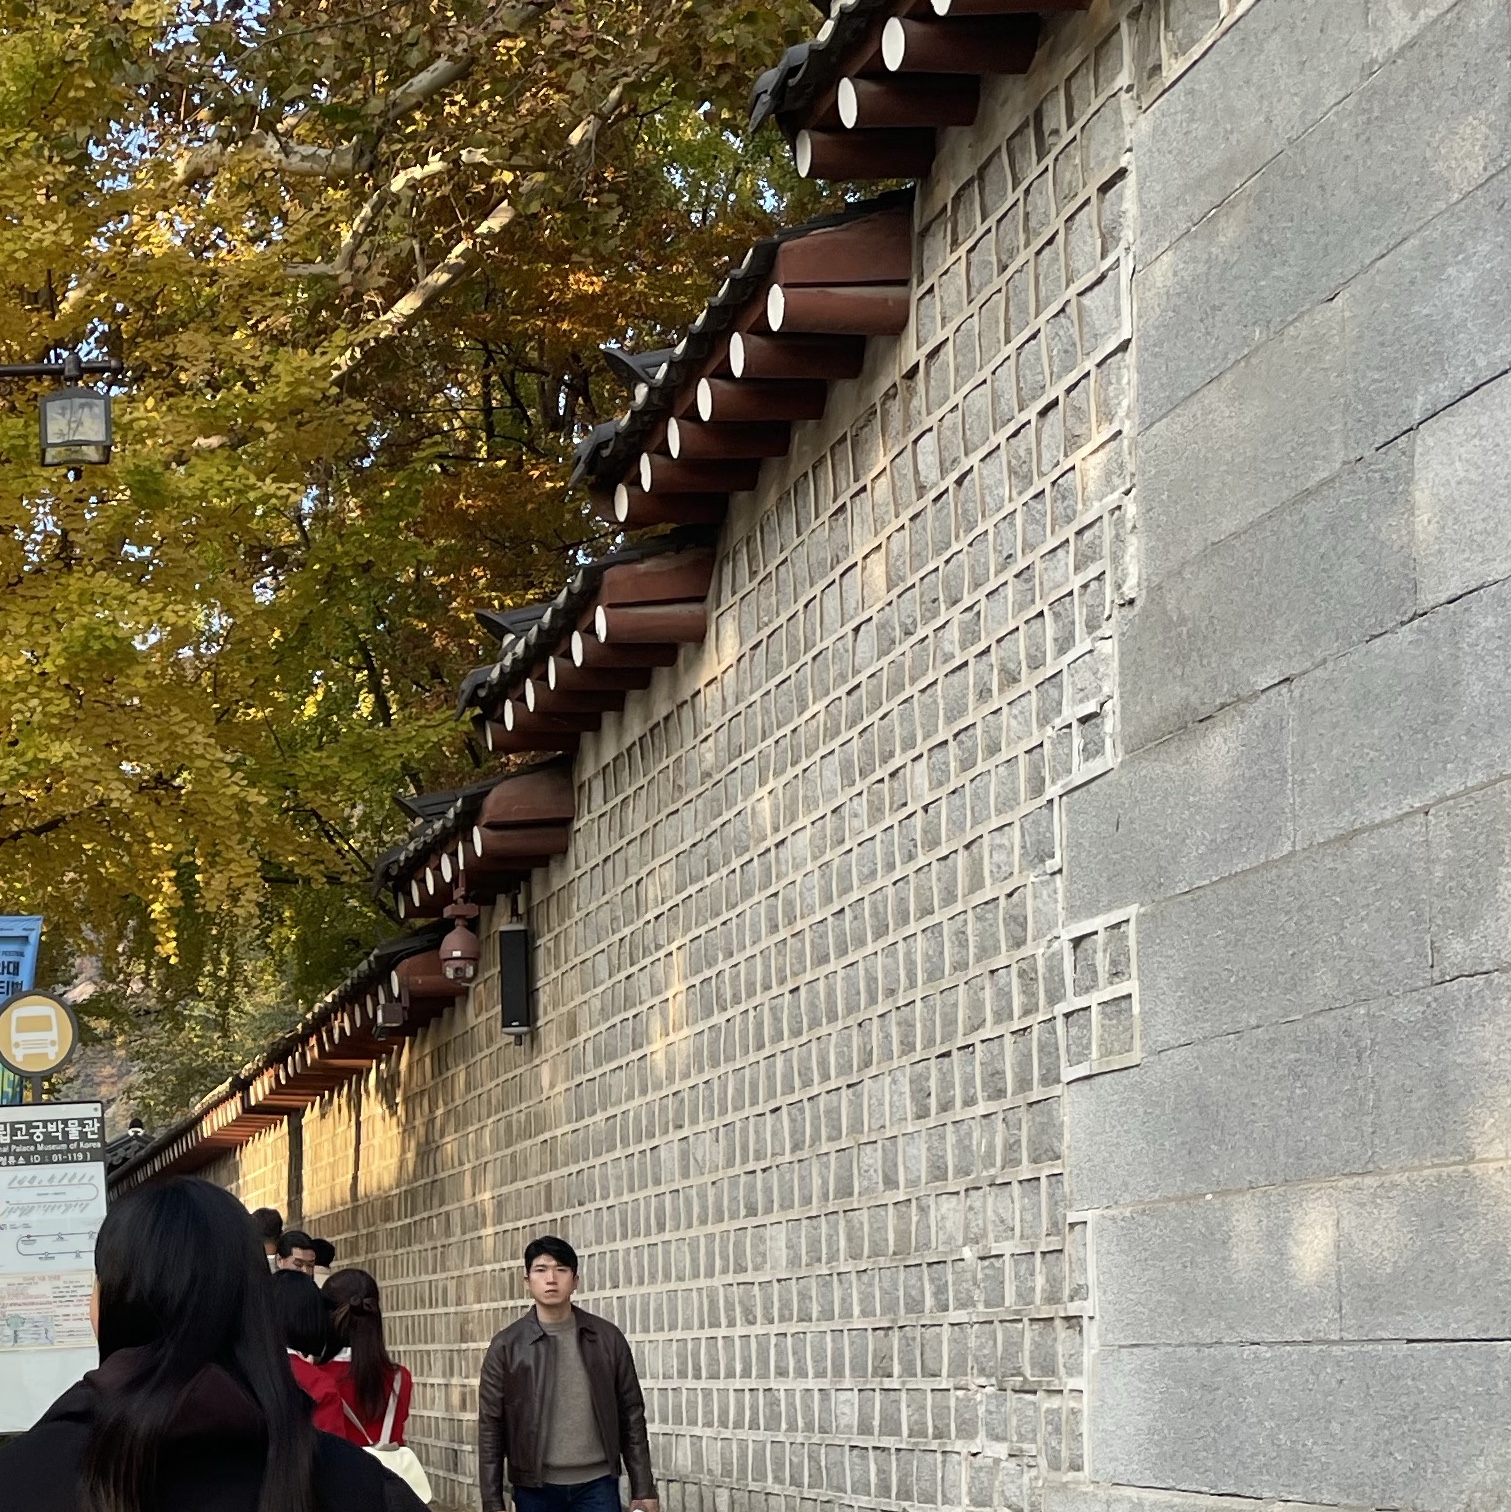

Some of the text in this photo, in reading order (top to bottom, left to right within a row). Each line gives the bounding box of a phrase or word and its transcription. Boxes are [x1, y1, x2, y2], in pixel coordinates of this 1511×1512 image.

[11, 1144, 35, 1152] Palace
[37, 1143, 68, 1151] Museum
[69, 1141, 78, 1149] of
[79, 1141, 101, 1149] Korea
[30, 1154, 41, 1163] ID
[51, 1152, 84, 1162] 01-119
